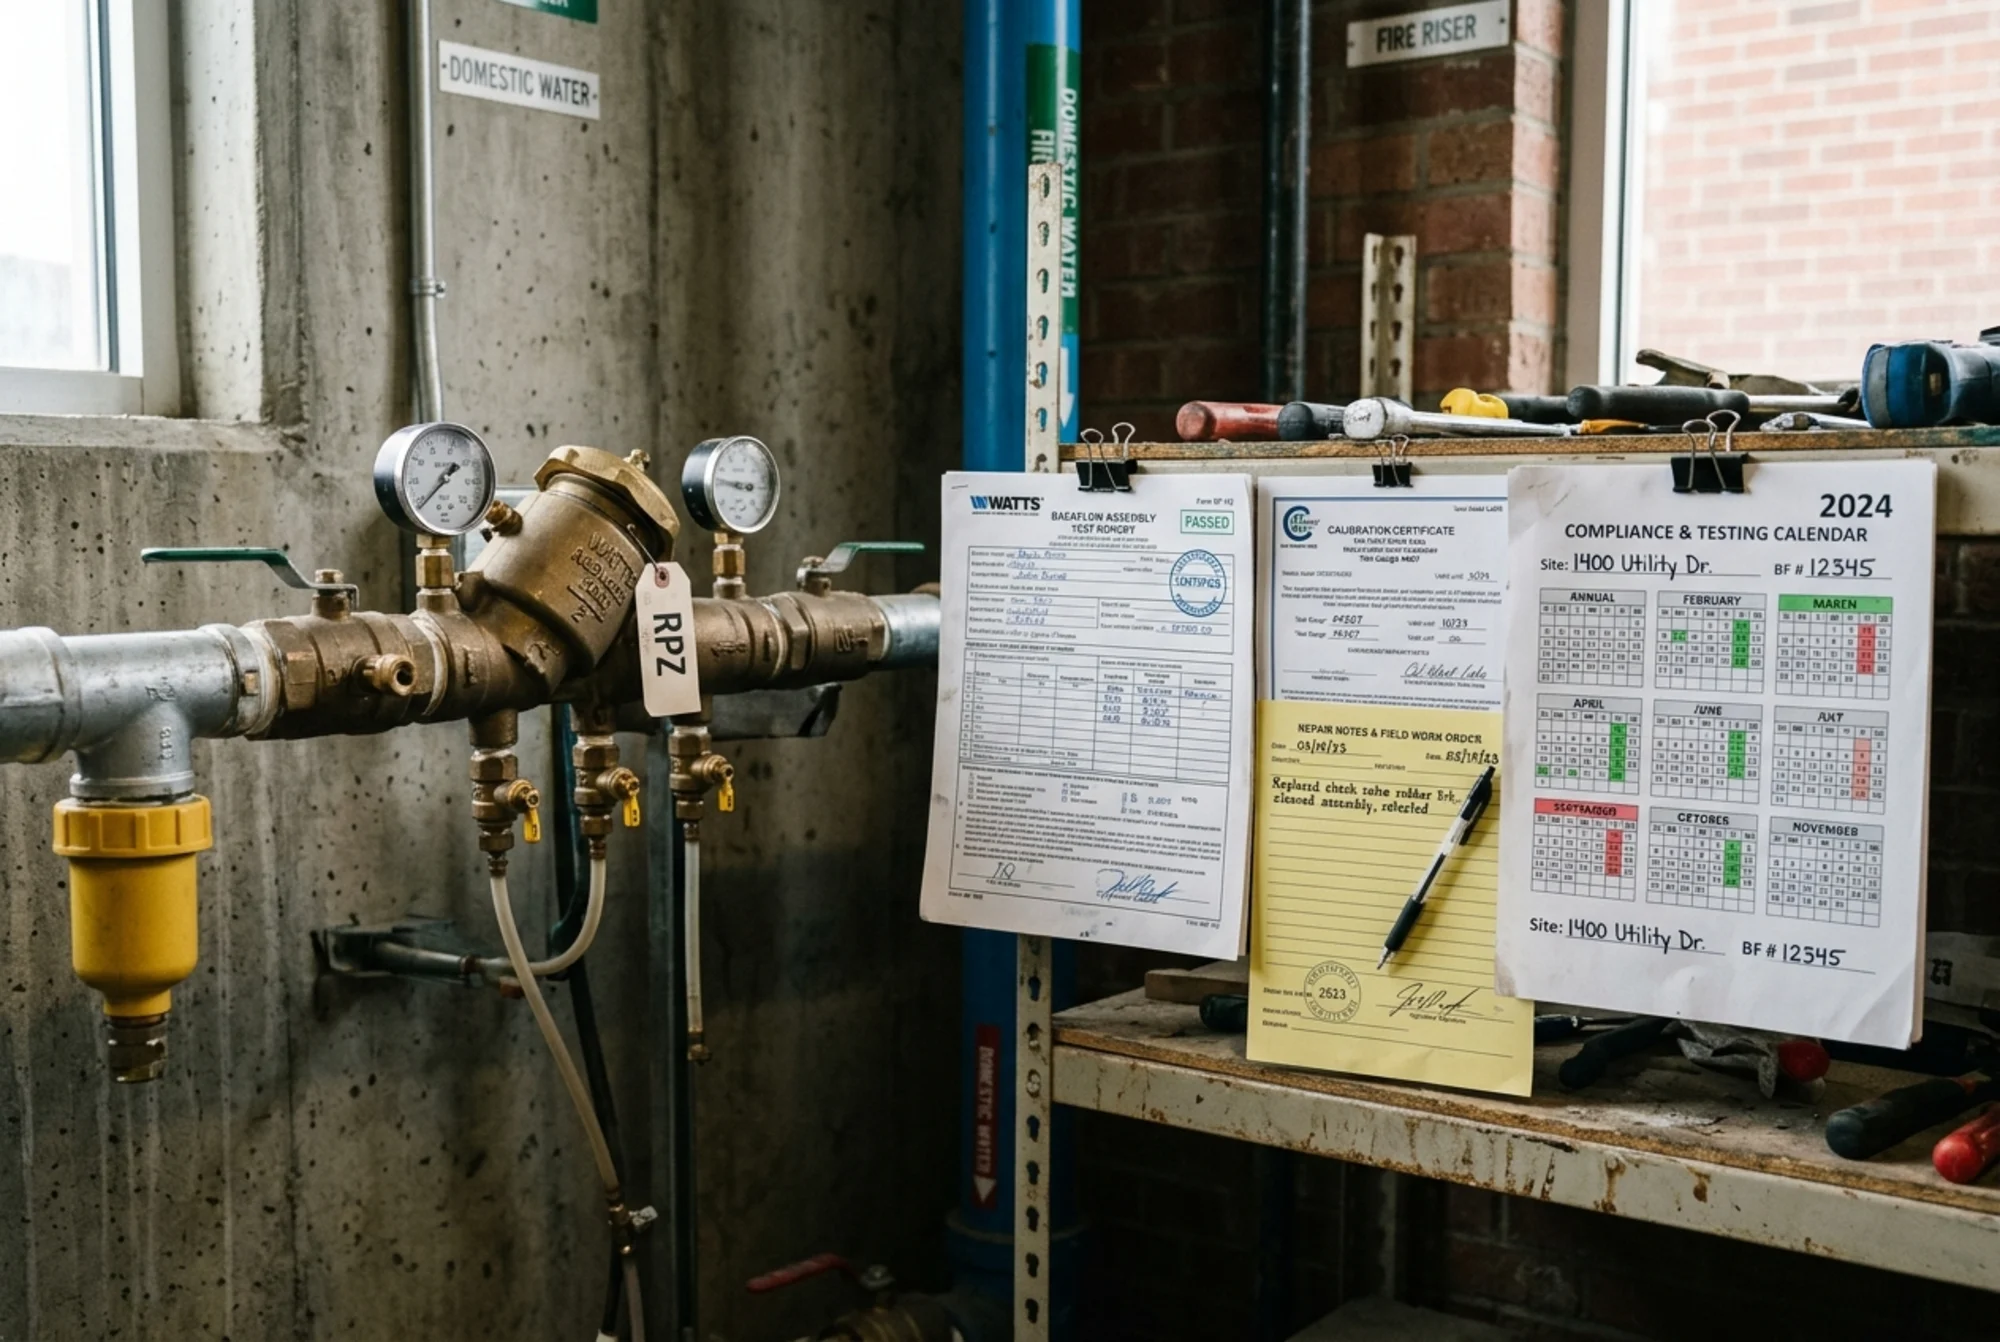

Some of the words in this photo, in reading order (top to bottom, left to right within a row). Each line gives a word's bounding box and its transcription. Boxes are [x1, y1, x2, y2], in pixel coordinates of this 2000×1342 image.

[1376, 22, 1416, 53] FIRE
[1422, 14, 1476, 46] RISER
[450, 54, 534, 95] DOMESTIC
[538, 72, 590, 106] WATER
[988, 496, 1041, 511] WATTS
[1819, 493, 1893, 519] 2024
[1185, 515, 1230, 529] PASSED
[1565, 523, 1674, 539] COMPLIANCE
[1679, 525, 1692, 540] &
[1697, 525, 1768, 541] TESTING
[1774, 526, 1868, 542] CALENDAR
[1540, 558, 1569, 571] Site:
[1574, 552, 1614, 571] 1400
[1621, 553, 1677, 581] Utility
[1686, 554, 1712, 574] Dr.
[1774, 563, 1791, 575] BF
[1795, 564, 1804, 575] #
[1811, 557, 1876, 577] 12345
[1570, 592, 1615, 602] ANNUAL
[1683, 594, 1741, 605] FEBRUARY
[653, 613, 686, 677] RPZ
[1573, 698, 1605, 709] APRIL
[1335, 725, 1368, 737] NOTES
[1380, 729, 1409, 740] FIELD
[1529, 917, 1563, 934] Site:
[1568, 918, 1607, 939] 1400
[1615, 922, 1671, 954] Utility
[1678, 929, 1706, 951] Dr.
[1742, 940, 1763, 956] BF
[1766, 943, 1777, 958] #
